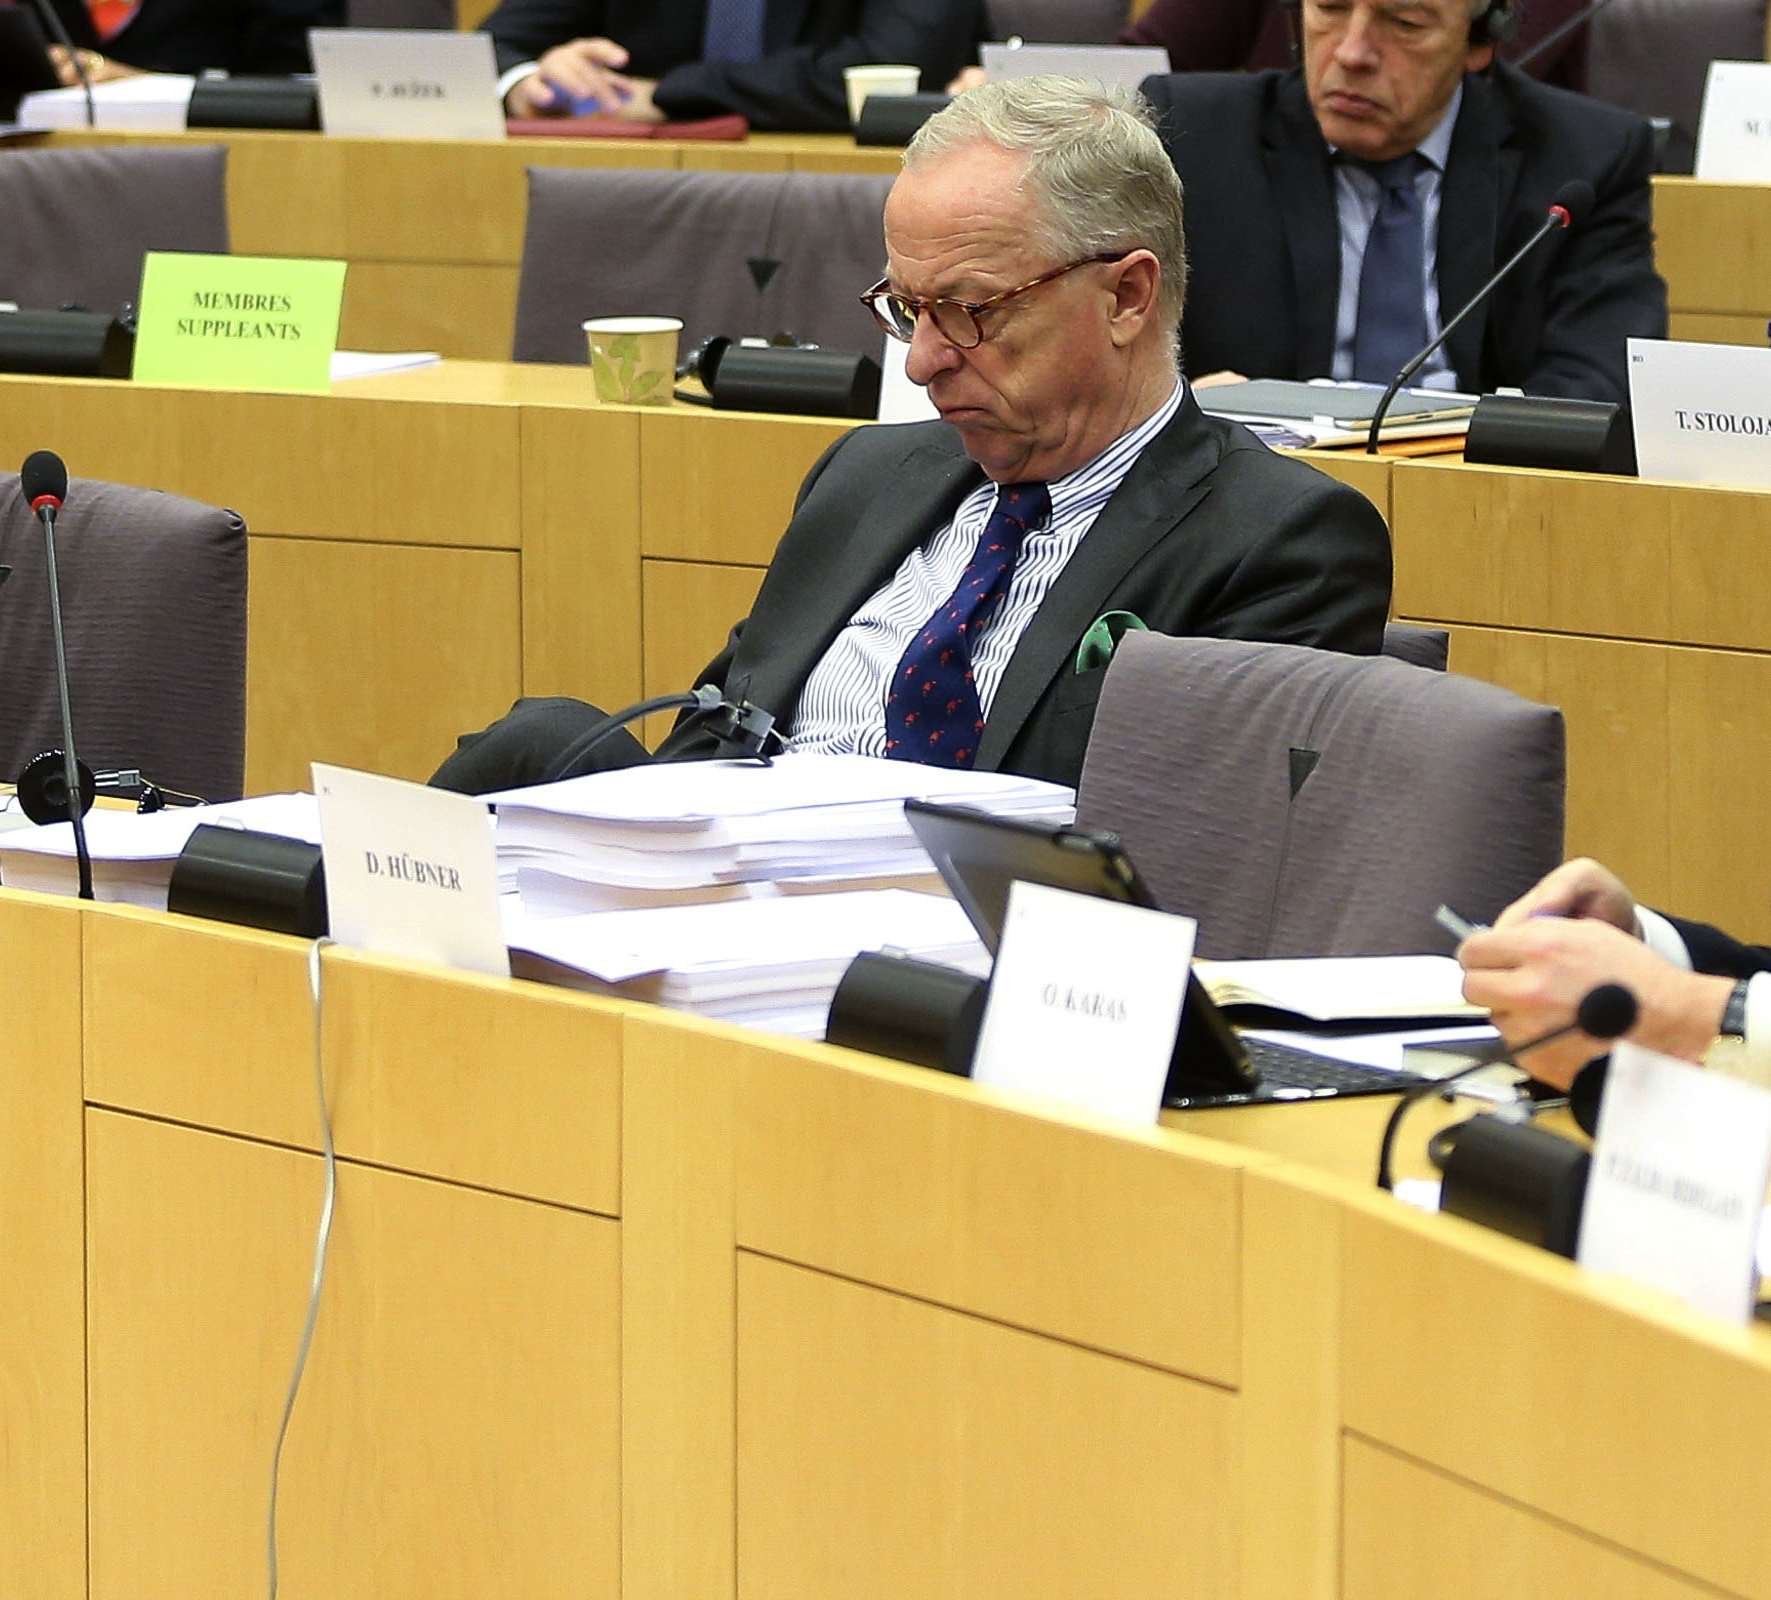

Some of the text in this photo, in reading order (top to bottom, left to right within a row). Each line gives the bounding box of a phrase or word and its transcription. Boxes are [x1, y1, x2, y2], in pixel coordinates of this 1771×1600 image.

[192, 292, 292, 312] MEMBRES
[177, 319, 301, 341] SUPPLEANTS
[1675, 411, 1691, 430] T.
[365, 851, 462, 892] D. HÜBNER
